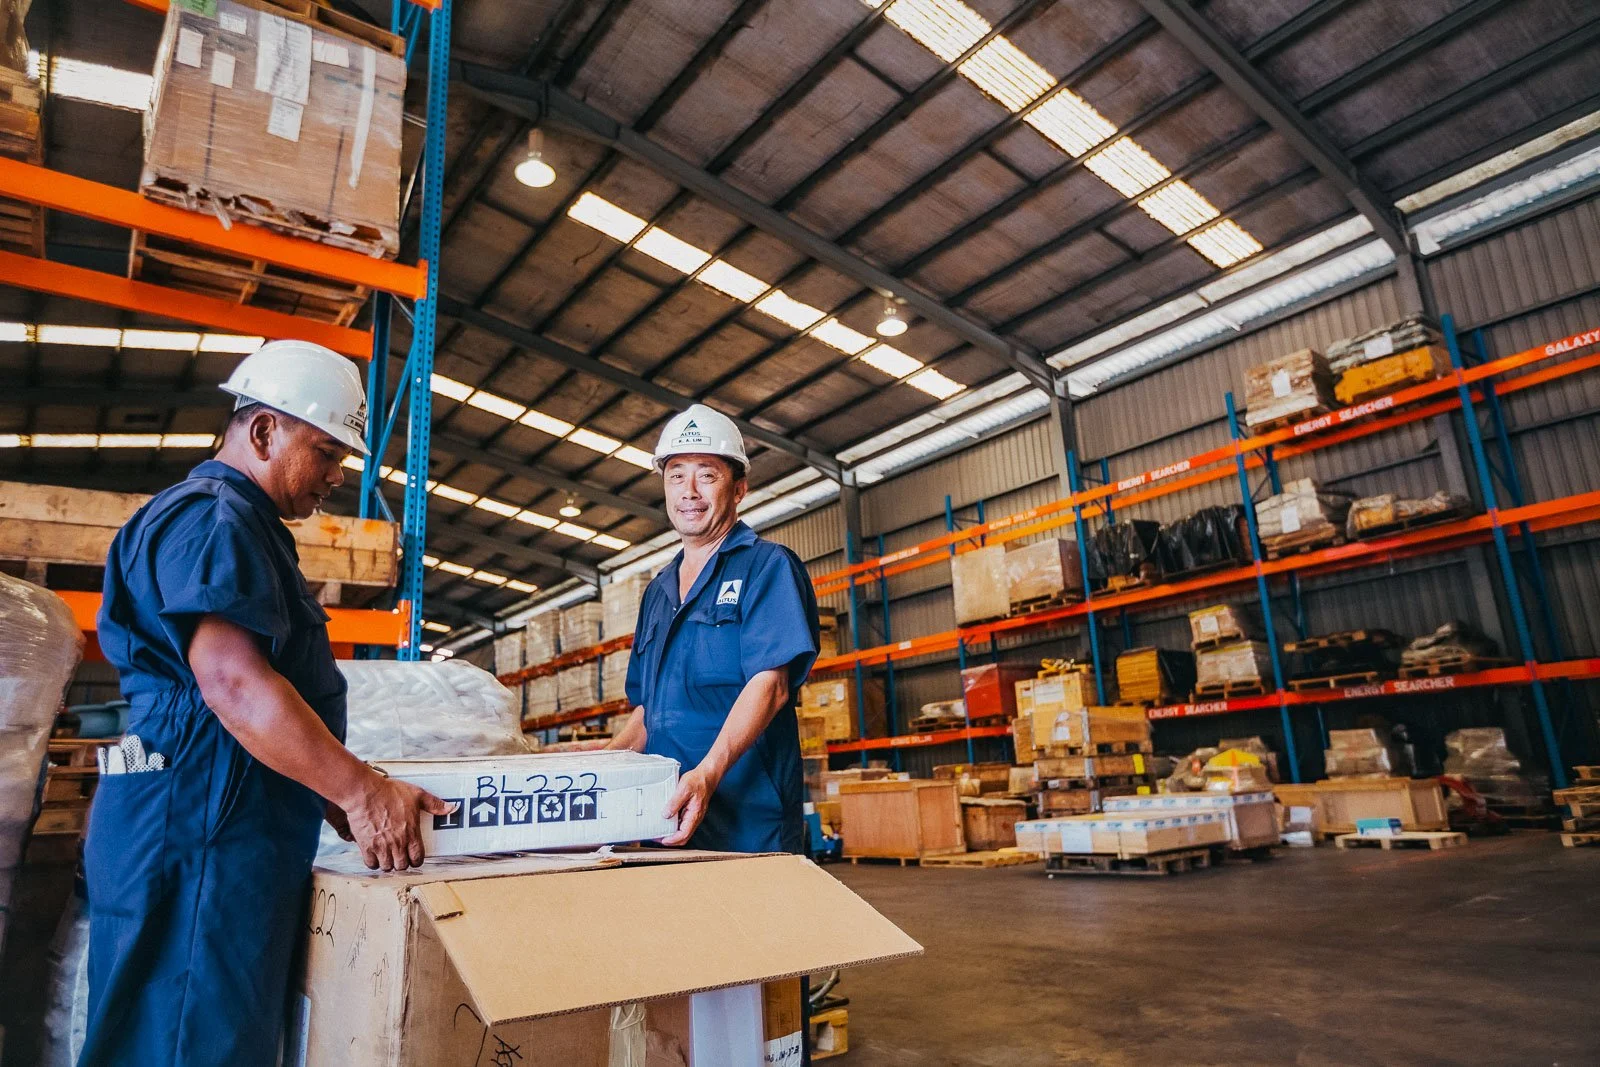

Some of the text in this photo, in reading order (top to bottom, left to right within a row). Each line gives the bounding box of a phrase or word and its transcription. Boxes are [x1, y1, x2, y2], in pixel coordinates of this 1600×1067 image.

[1545, 330, 1600, 356] GALAXY
[1294, 396, 1393, 435] ENERGY SEARCHER
[1151, 460, 1190, 481] SEARCHER
[1344, 676, 1454, 698] ENERGY SEARCHER
[1148, 701, 1228, 719] ENERGY SEARCHER
